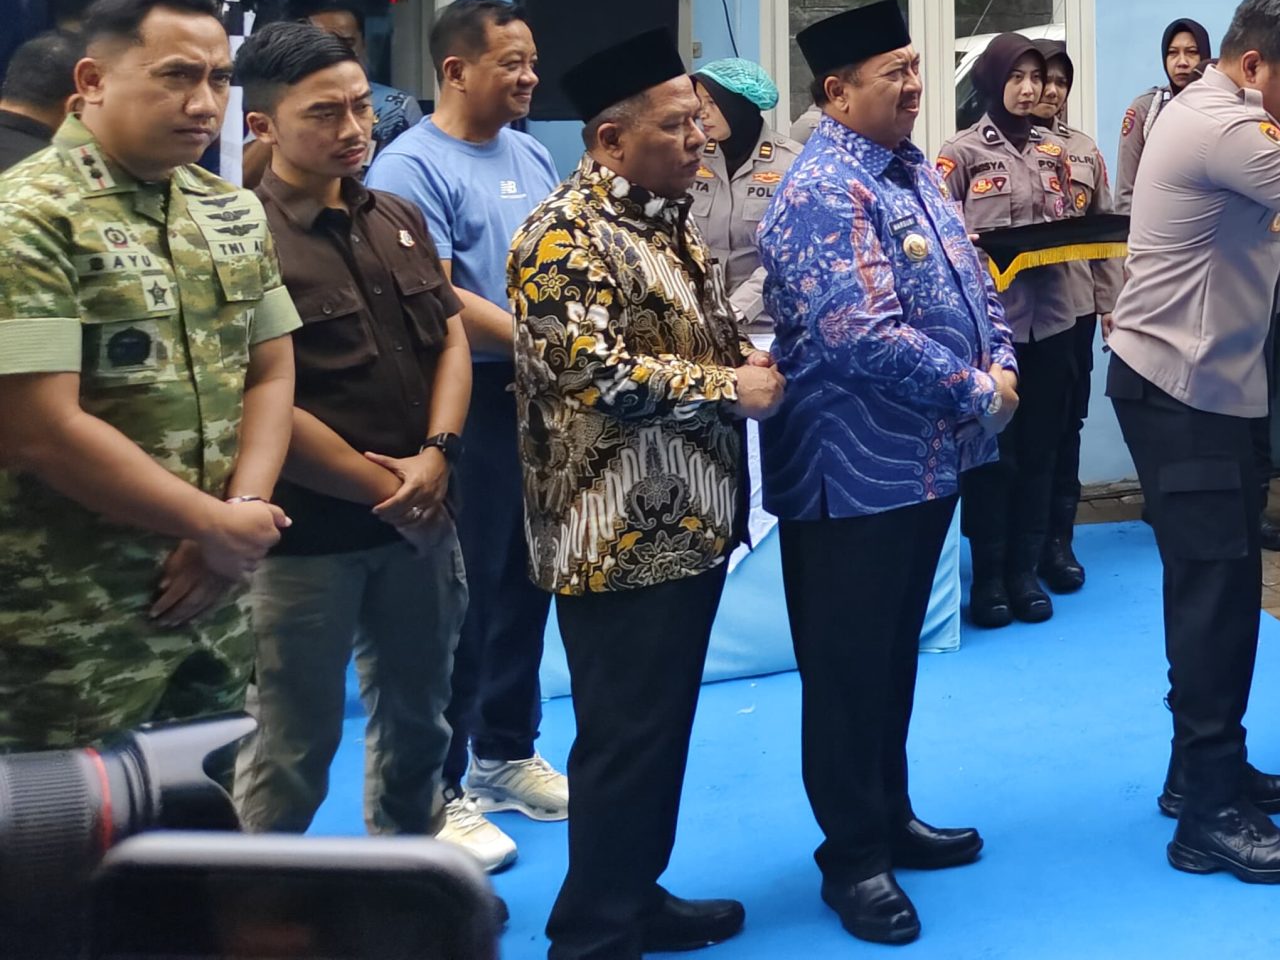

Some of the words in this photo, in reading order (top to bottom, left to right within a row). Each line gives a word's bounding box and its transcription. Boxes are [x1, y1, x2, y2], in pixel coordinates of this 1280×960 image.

[1066, 154, 1094, 165] OLRI
[747, 186, 774, 198] POL
[219, 243, 246, 256] TNI
